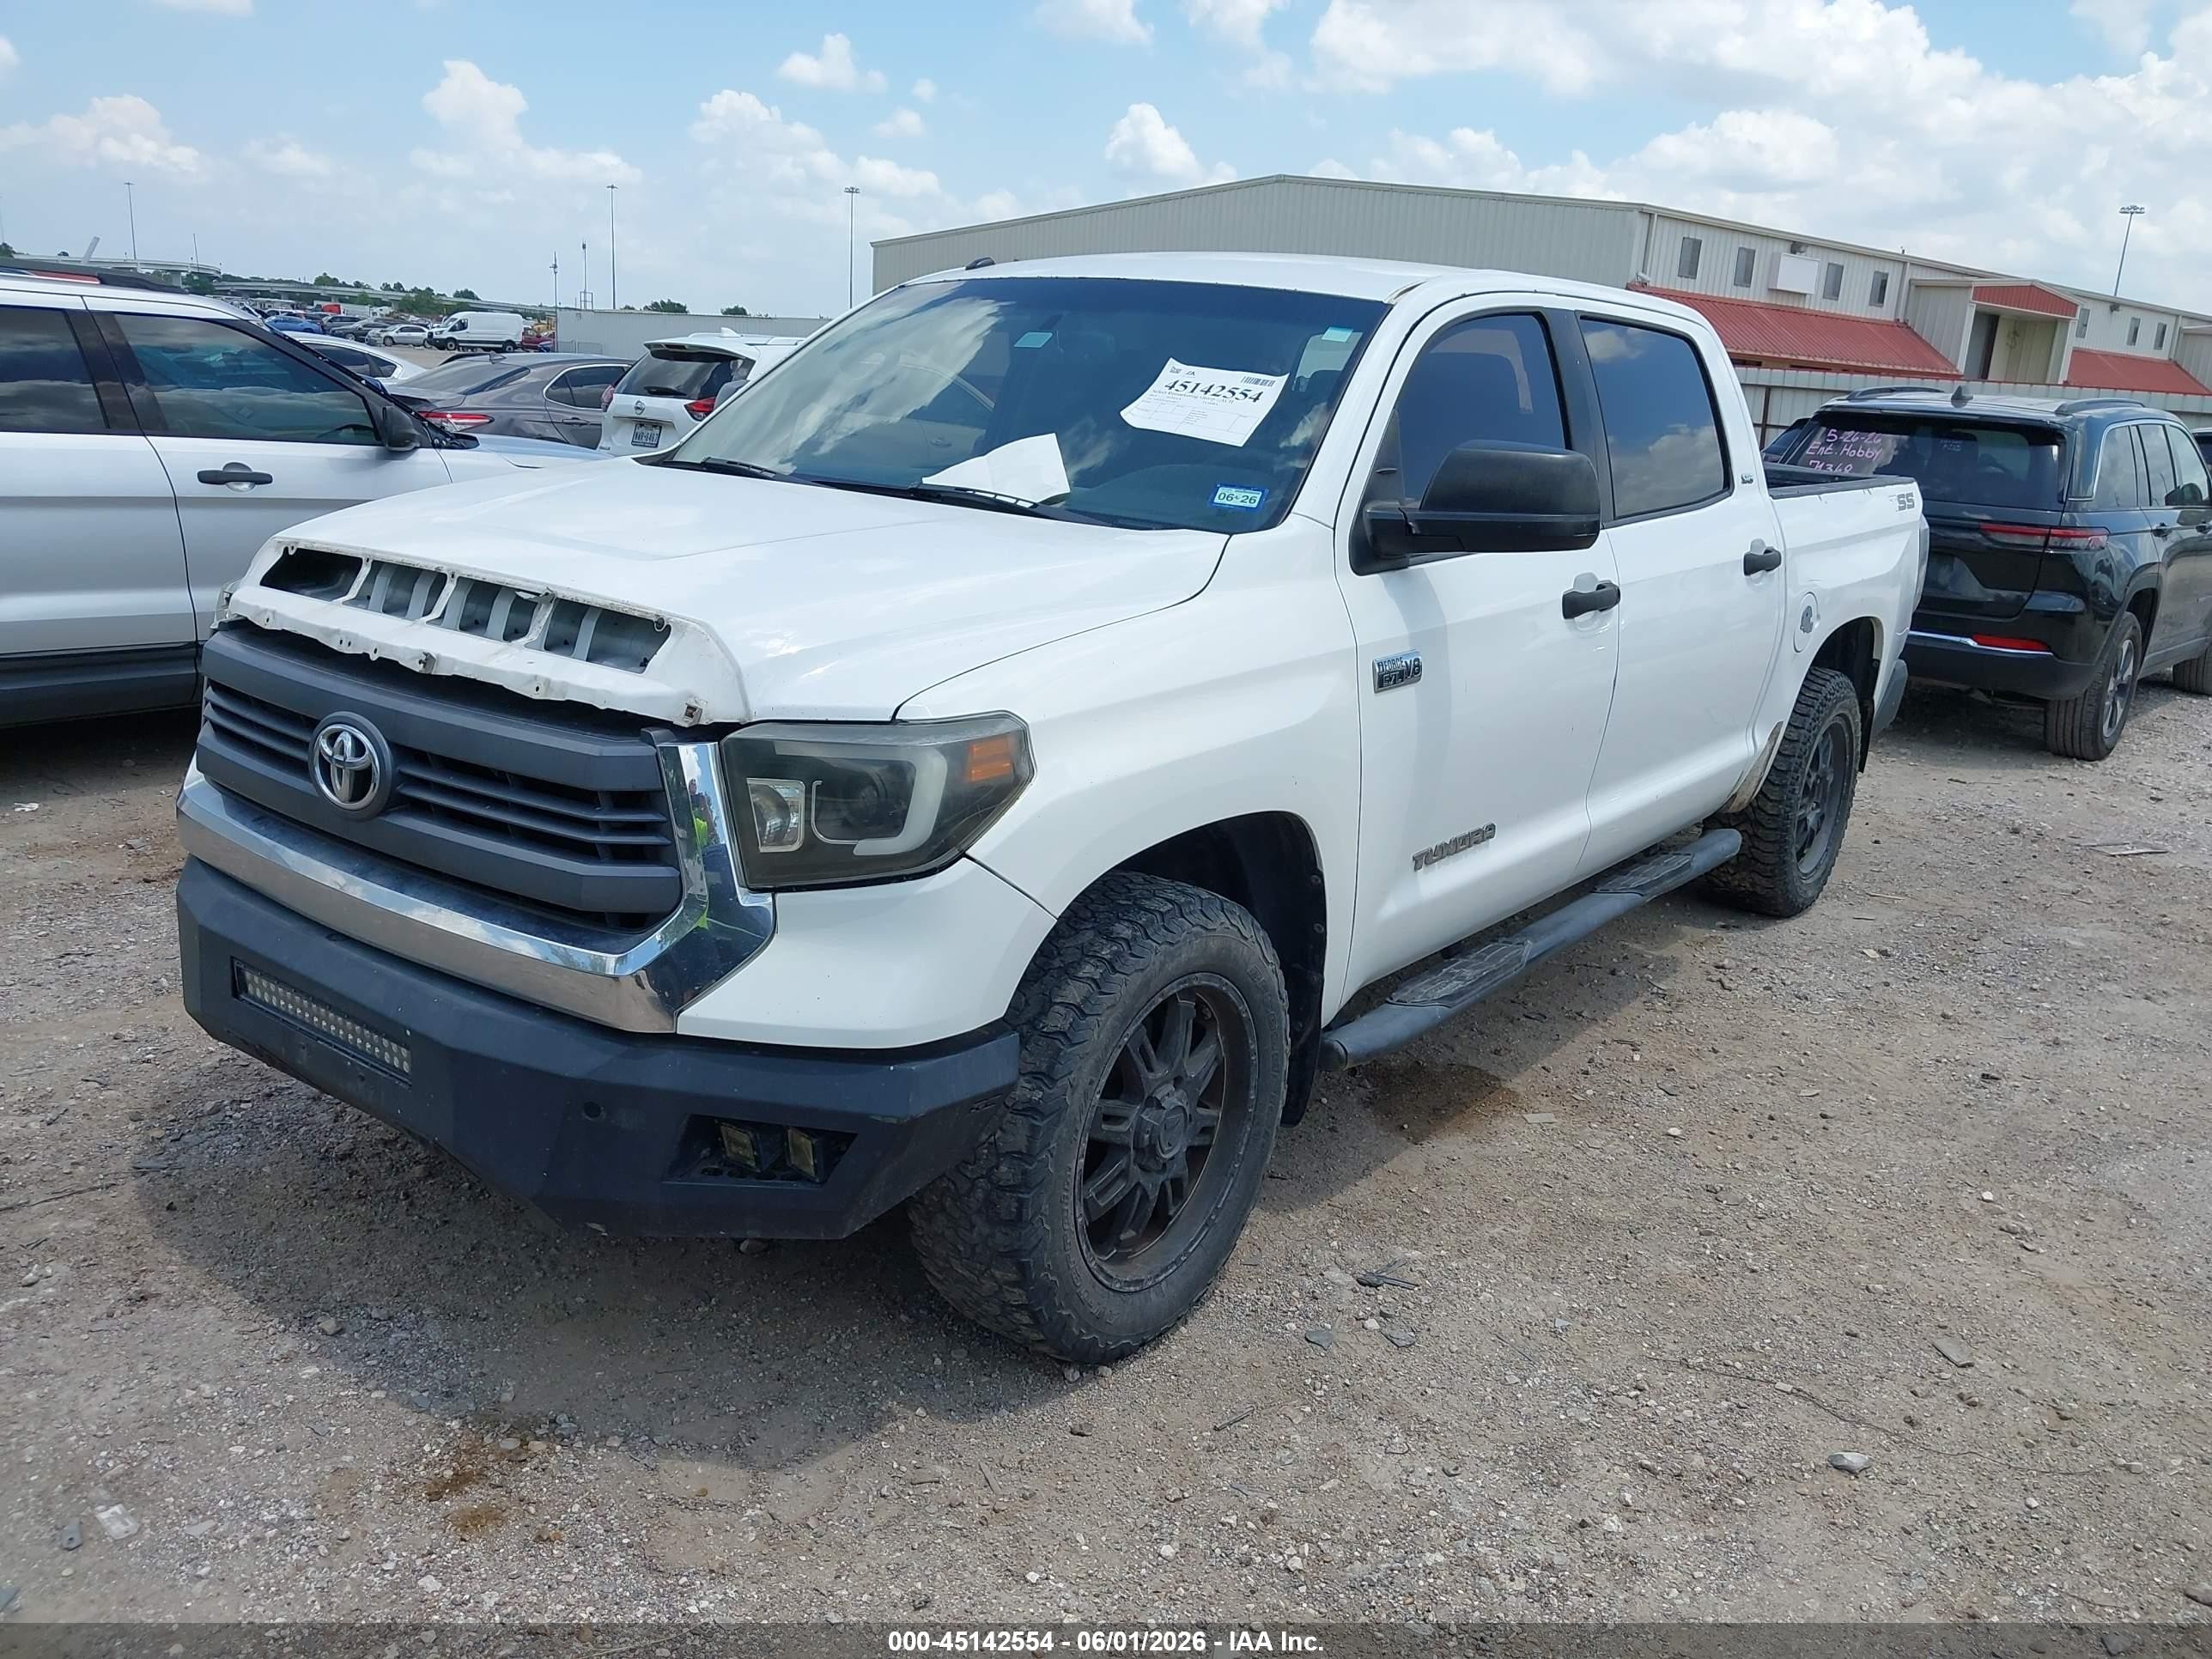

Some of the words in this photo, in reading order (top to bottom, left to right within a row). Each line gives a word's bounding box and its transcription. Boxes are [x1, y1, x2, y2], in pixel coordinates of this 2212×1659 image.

[1164, 379, 1264, 404] 45142554
[1826, 428, 1883, 444] 5-26-26
[1839, 443, 1883, 461] Hobby
[1218, 492, 1235, 502] 06
[1240, 495, 1258, 504] 26
[1404, 657, 1421, 678] V8
[1412, 823, 1496, 872] TUNDRA
